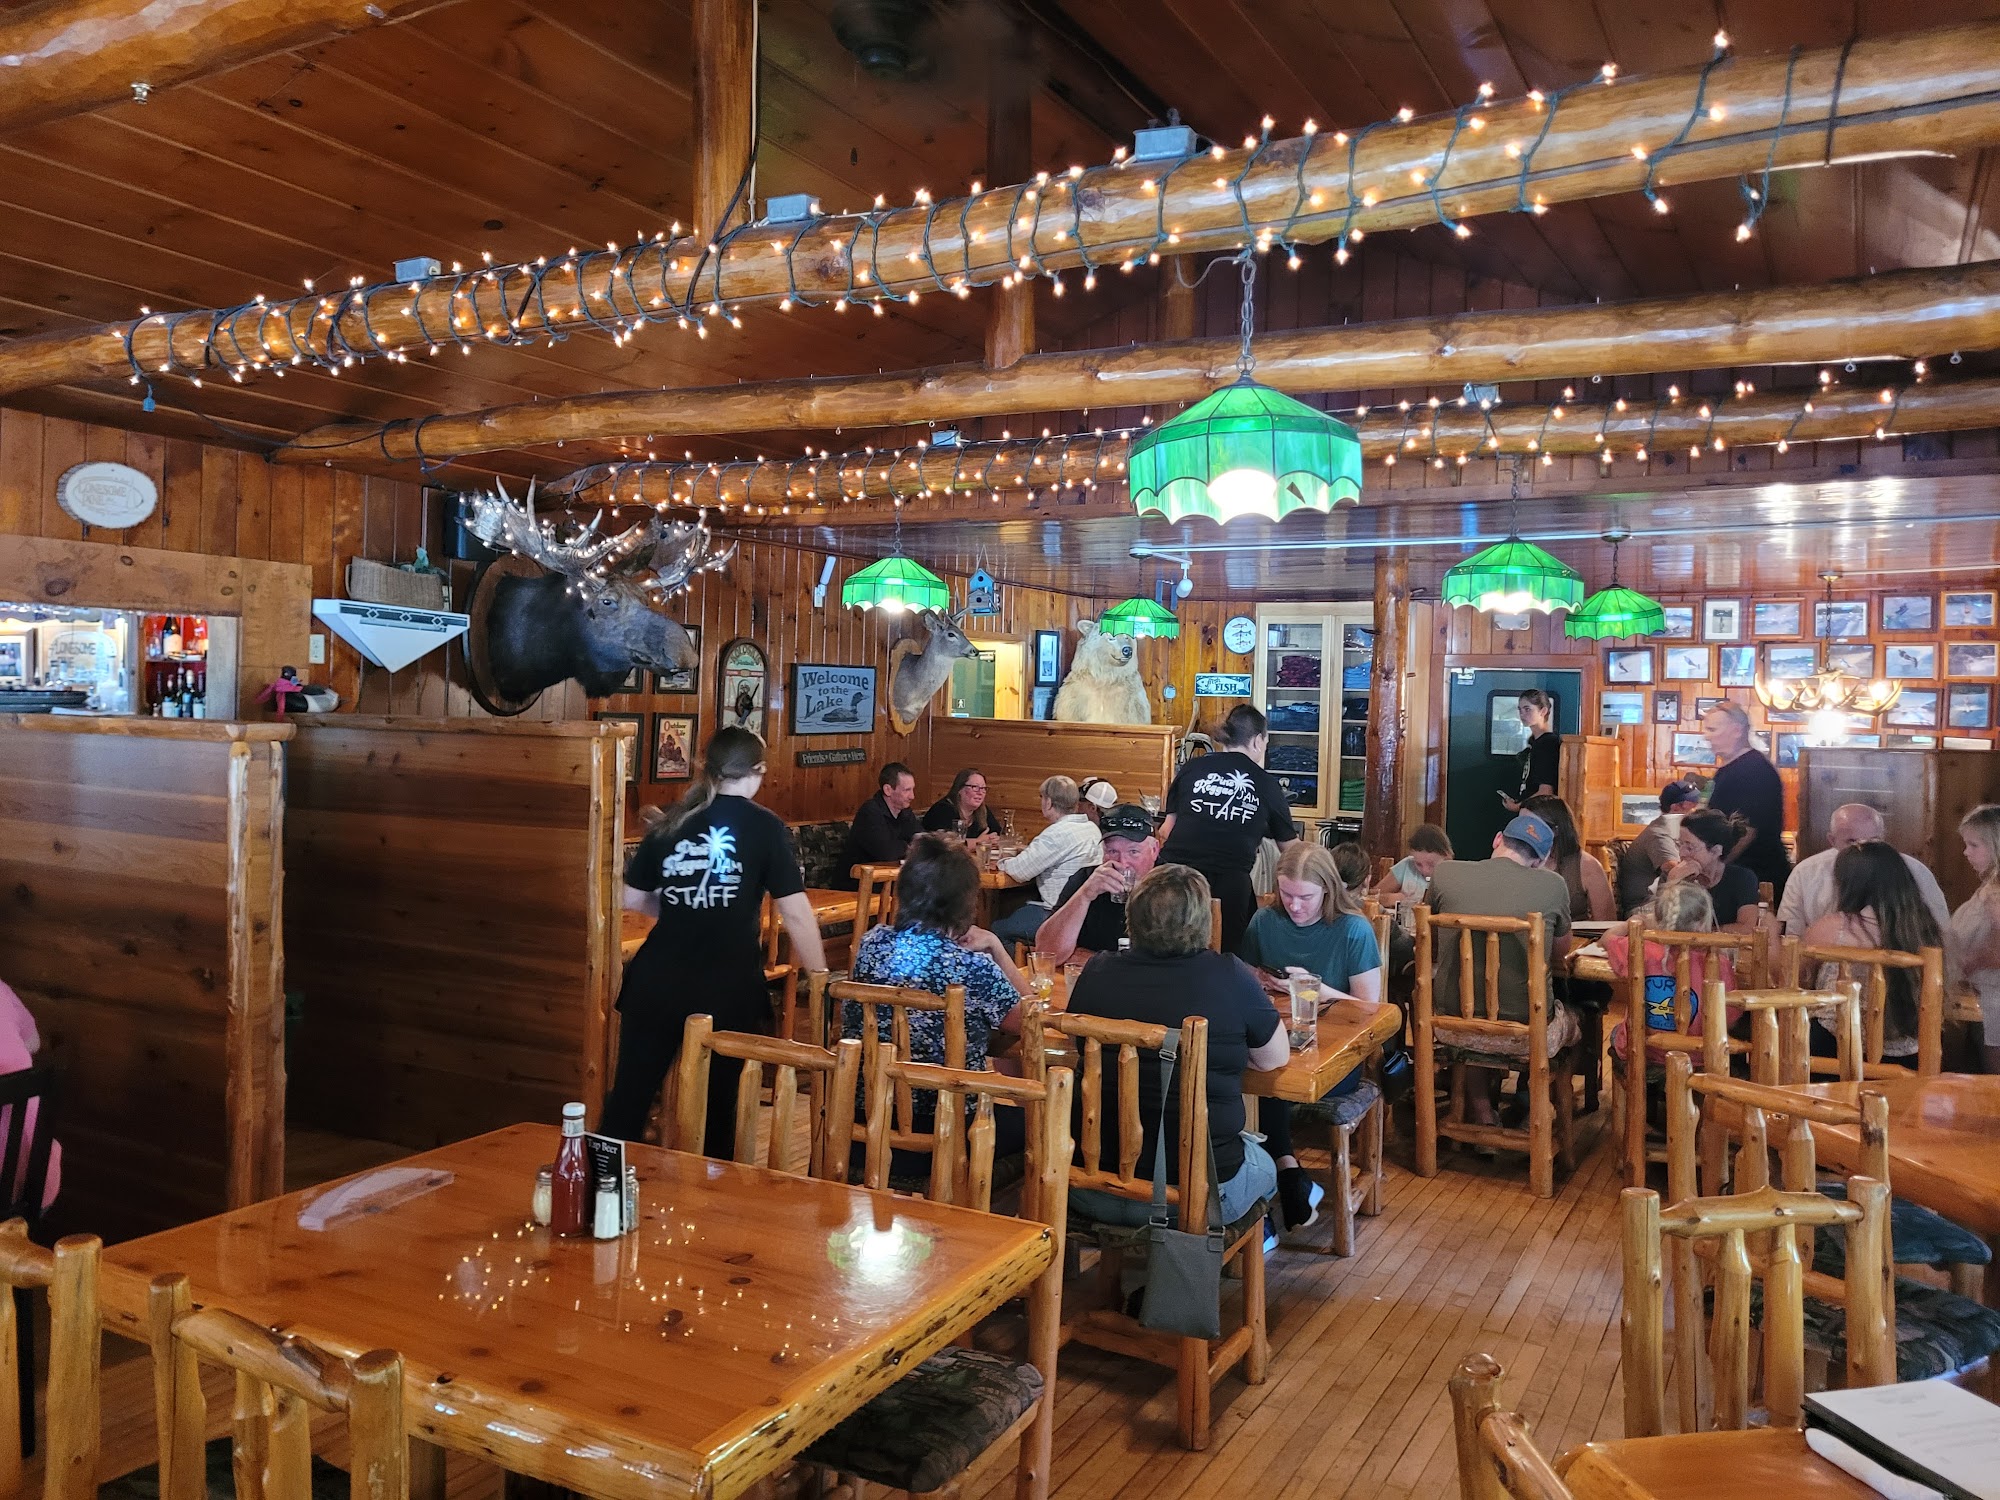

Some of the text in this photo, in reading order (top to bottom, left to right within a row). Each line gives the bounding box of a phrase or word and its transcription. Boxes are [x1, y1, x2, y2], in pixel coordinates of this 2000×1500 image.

[801, 670, 869, 690] Welcome
[1215, 683, 1237, 691] FISH
[818, 686, 849, 696] to the
[804, 694, 843, 720] Lake
[1193, 778, 1235, 796] Reggae
[1236, 790, 1260, 806] JAM
[1190, 799, 1255, 824] STAFF
[711, 857, 743, 874] JAM
[663, 885, 740, 909] STAFF
[587, 1137, 619, 1155] Tap Beer
